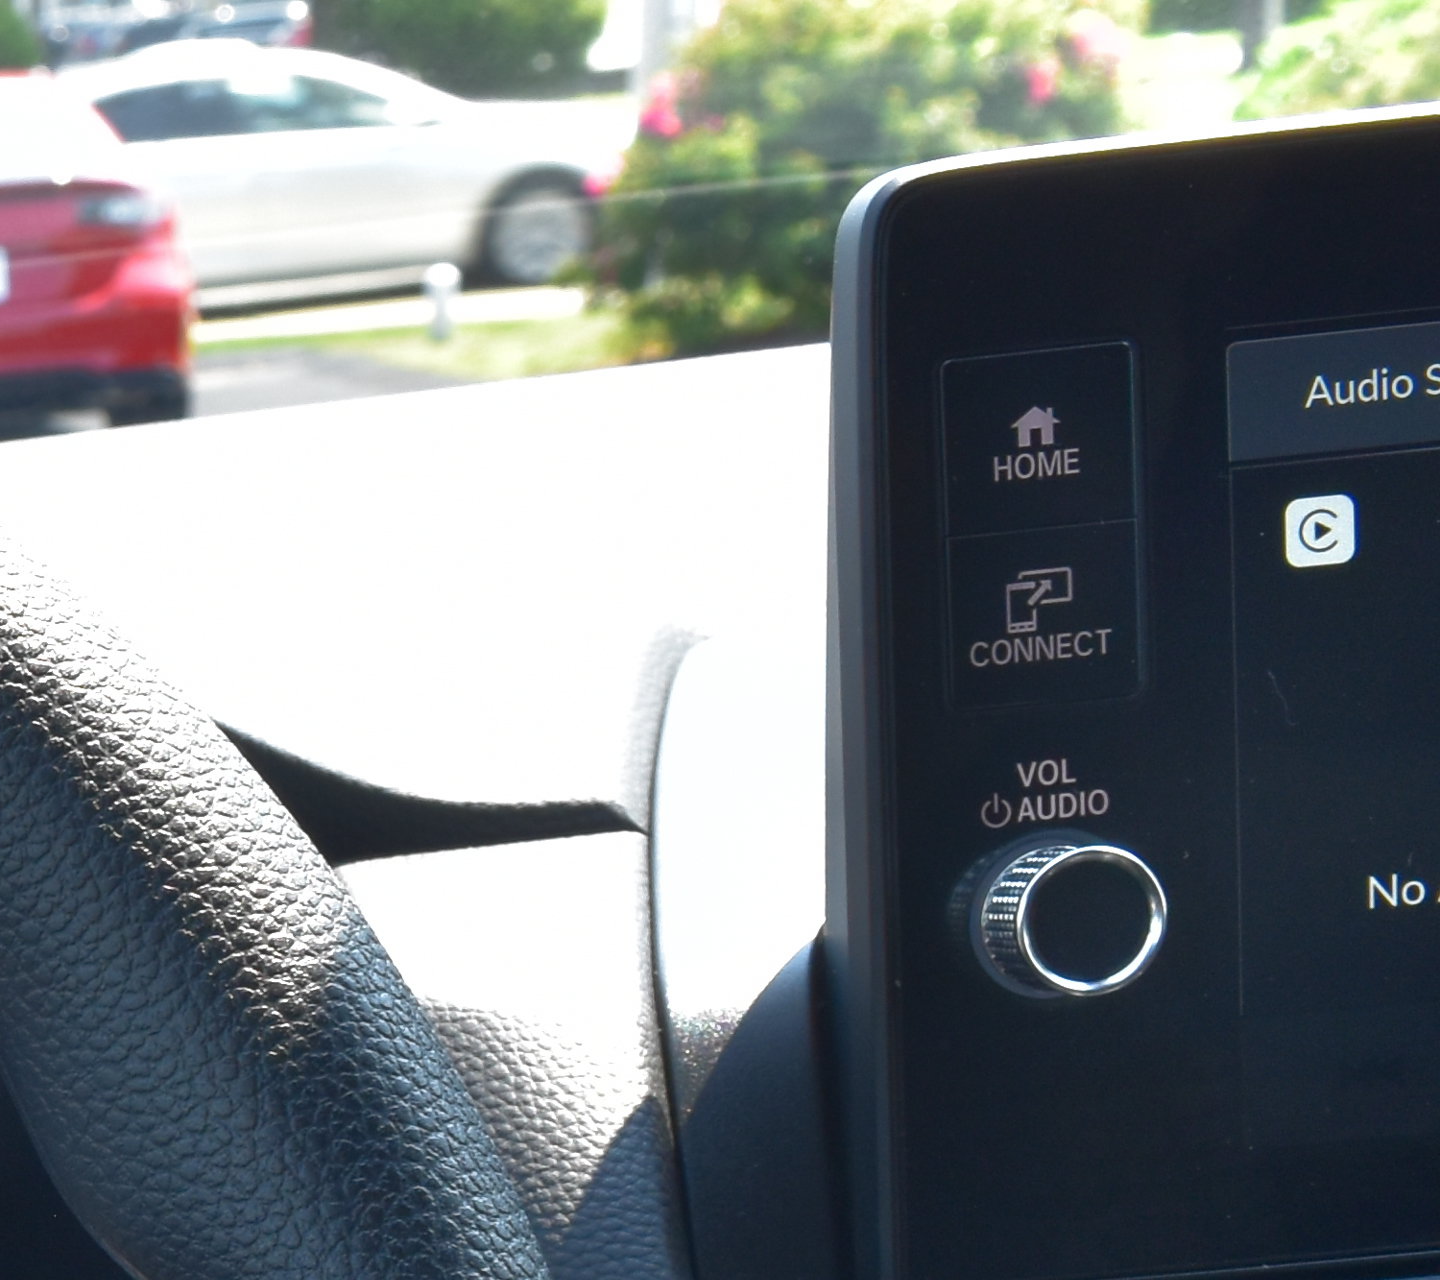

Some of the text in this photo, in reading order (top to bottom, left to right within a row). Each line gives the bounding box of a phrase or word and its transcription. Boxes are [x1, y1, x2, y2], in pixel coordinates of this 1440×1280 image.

[1305, 367, 1414, 408] Audio
[993, 448, 1081, 483] HOME
[969, 629, 1113, 668] CONNECT
[1016, 759, 1077, 788] VOL
[1017, 788, 1110, 822] AUDIO
[1368, 873, 1426, 909] No
